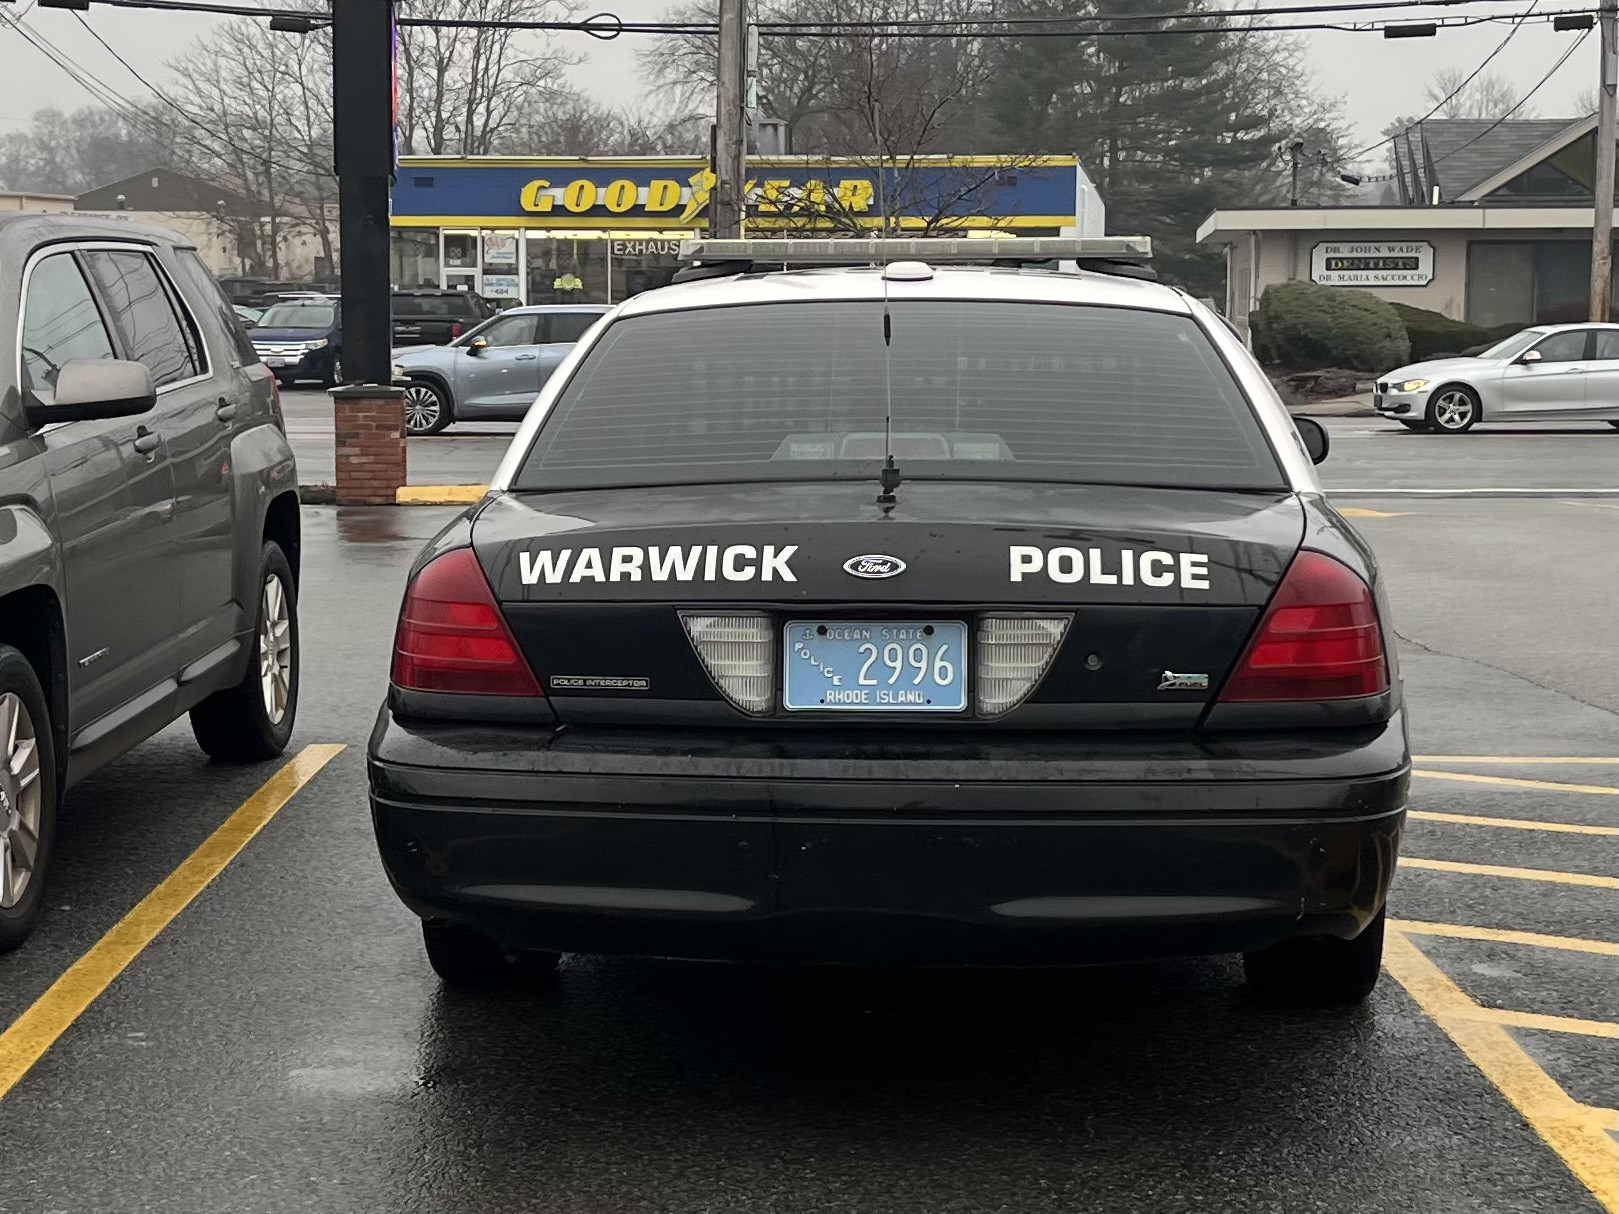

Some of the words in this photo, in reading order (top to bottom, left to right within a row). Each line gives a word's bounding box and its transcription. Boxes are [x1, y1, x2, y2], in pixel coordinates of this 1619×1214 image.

[520, 179, 875, 213] GOODEAR
[613, 240, 680, 255] EXHAUS
[1349, 245, 1381, 254] JOHN
[1387, 245, 1422, 254] WADE
[1330, 259, 1417, 269] DENTISTS
[1338, 273, 1370, 282] MARIA
[519, 545, 799, 585] WARWICK
[857, 559, 892, 573] Ford
[1009, 545, 1210, 590] POLICE
[826, 629, 871, 640] OCEAN
[881, 629, 923, 640] STATE
[794, 642, 843, 686] POLICE
[858, 643, 954, 686] 2996
[553, 678, 584, 686] POLICE
[586, 679, 647, 687] INTERCEPTOR
[826, 690, 870, 704] RHODE
[876, 690, 924, 704] ISLAND
